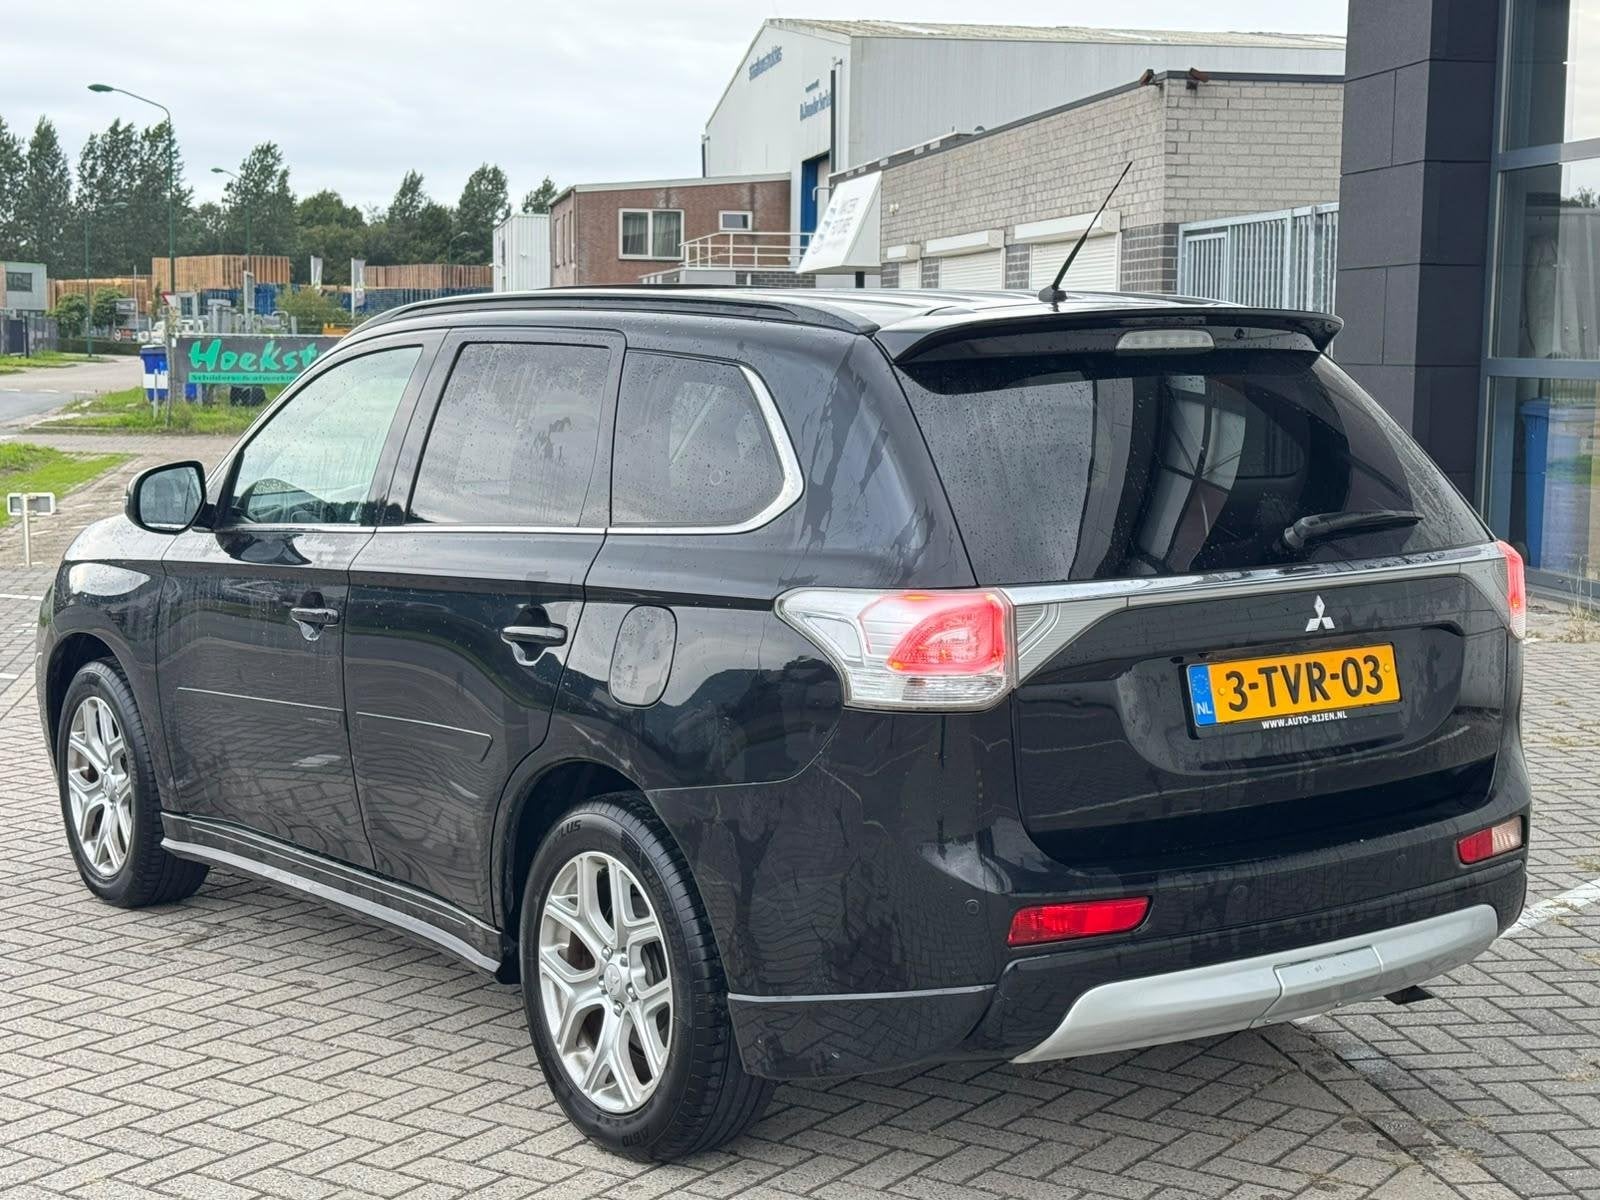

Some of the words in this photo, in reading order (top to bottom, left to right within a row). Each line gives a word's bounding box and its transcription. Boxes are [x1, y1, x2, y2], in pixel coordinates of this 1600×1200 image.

[188, 338, 322, 372] Hoekst
[1225, 654, 1383, 713] 3-TVR-03
[1196, 702, 1213, 715] NL
[1261, 711, 1347, 729] WWW.AUTO-RIJEN.NL
